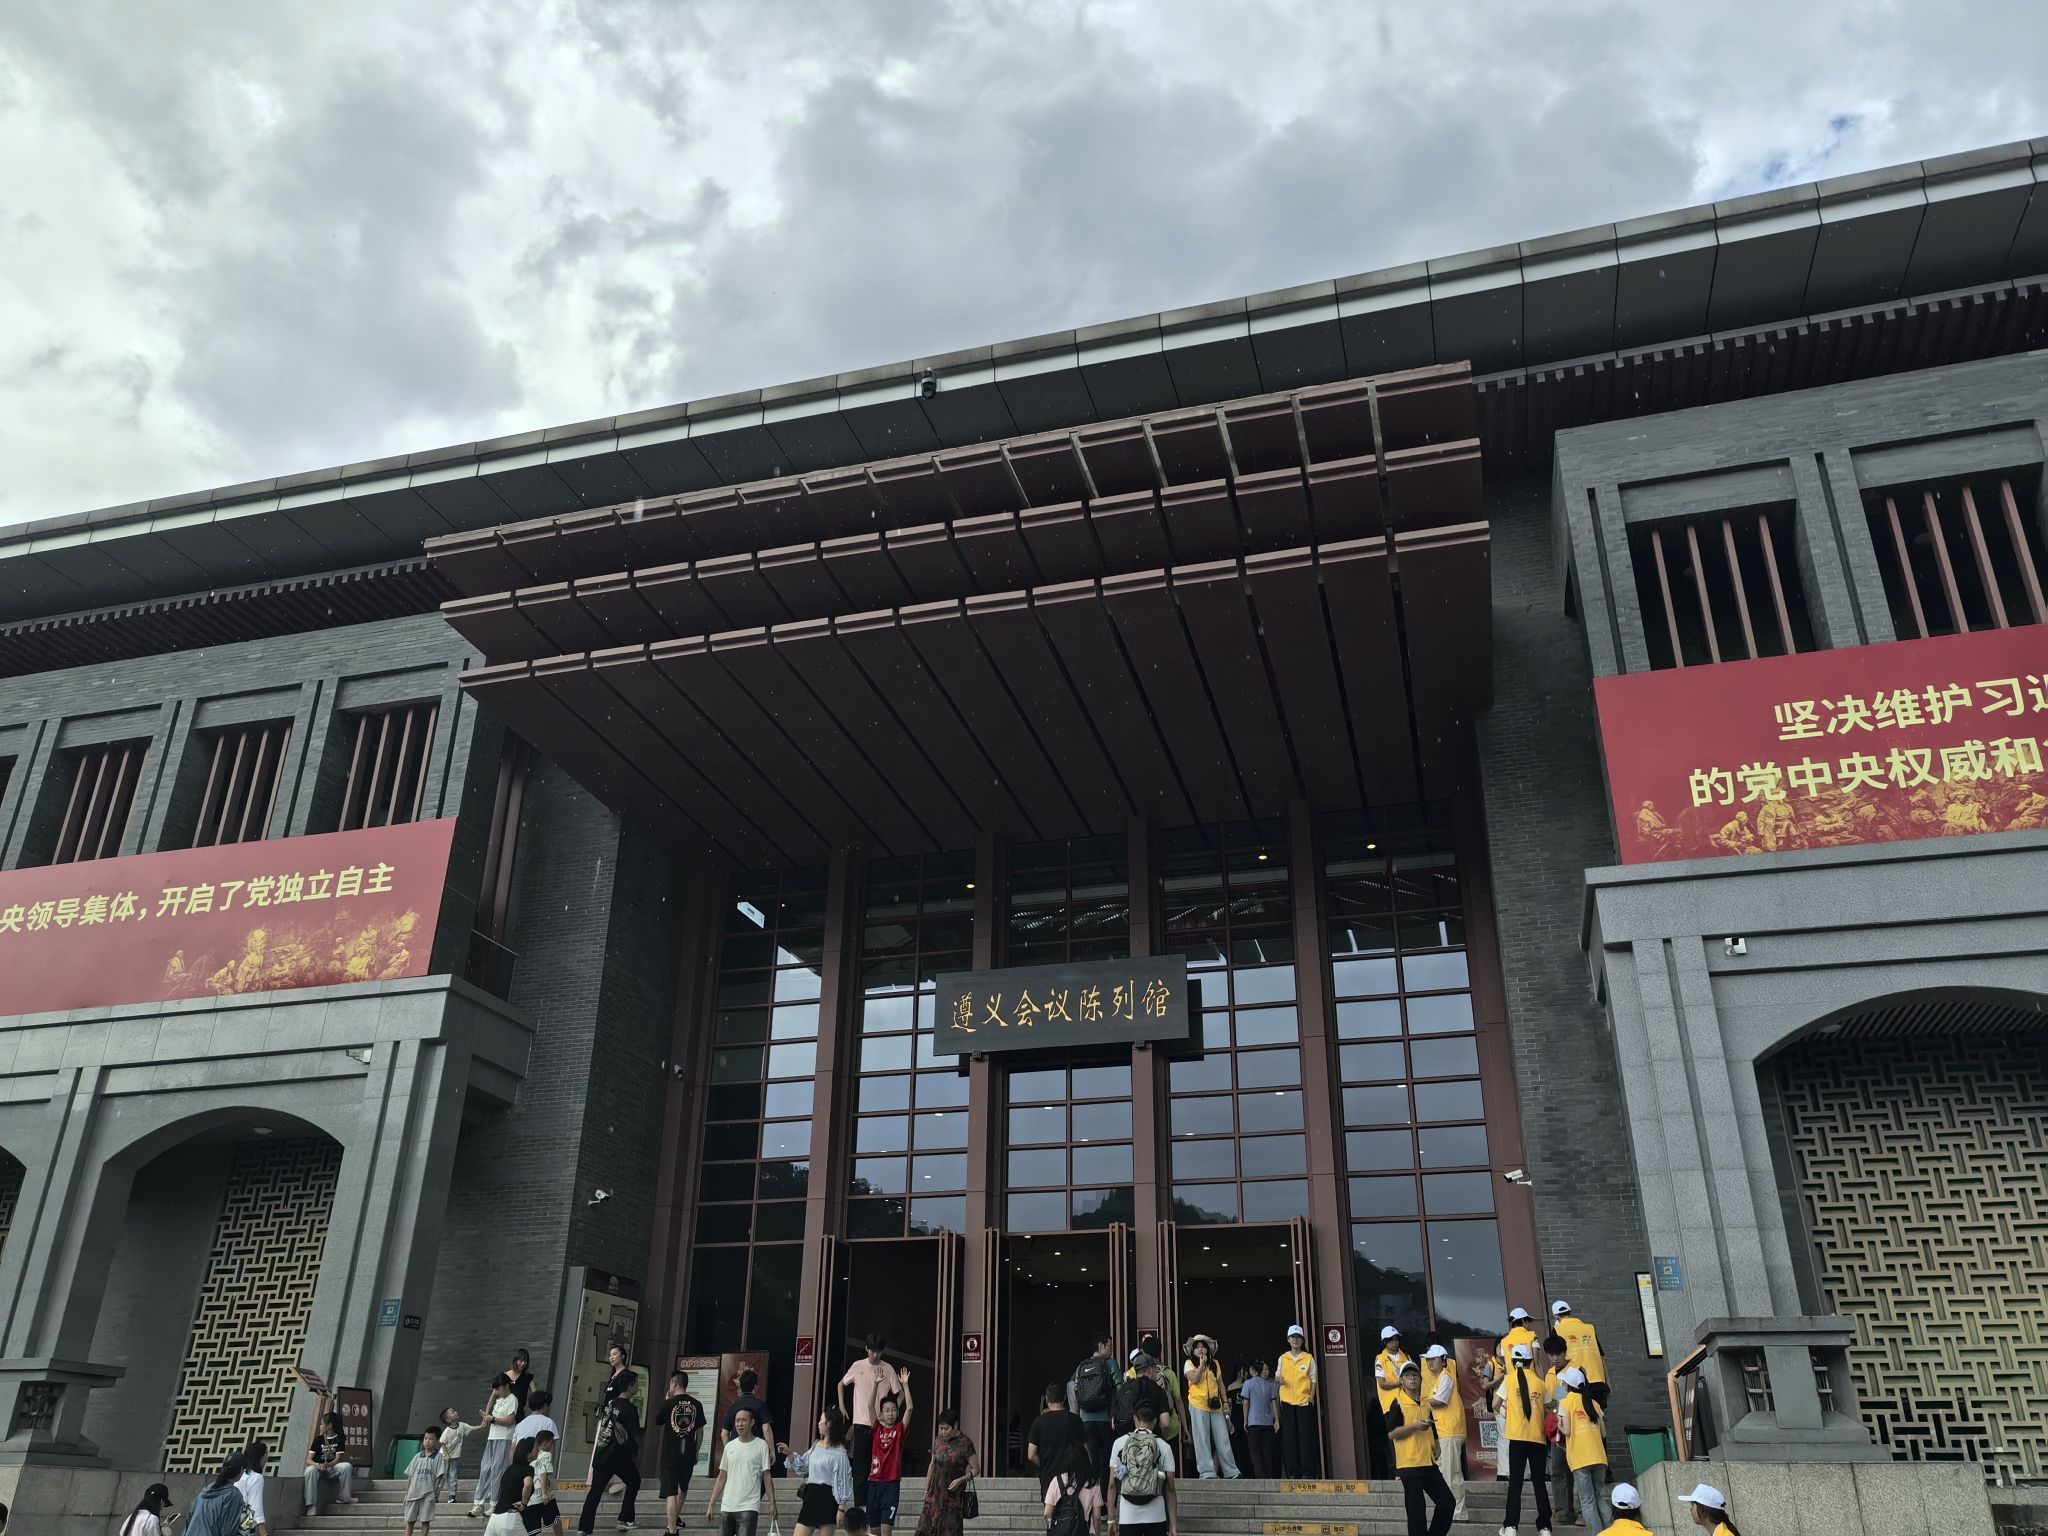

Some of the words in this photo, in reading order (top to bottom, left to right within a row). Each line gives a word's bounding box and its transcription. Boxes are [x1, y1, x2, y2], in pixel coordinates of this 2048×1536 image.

[1688, 737, 2048, 808] 的党中央权威和
[950, 978, 1171, 1033] 遵义会议陈列馆
